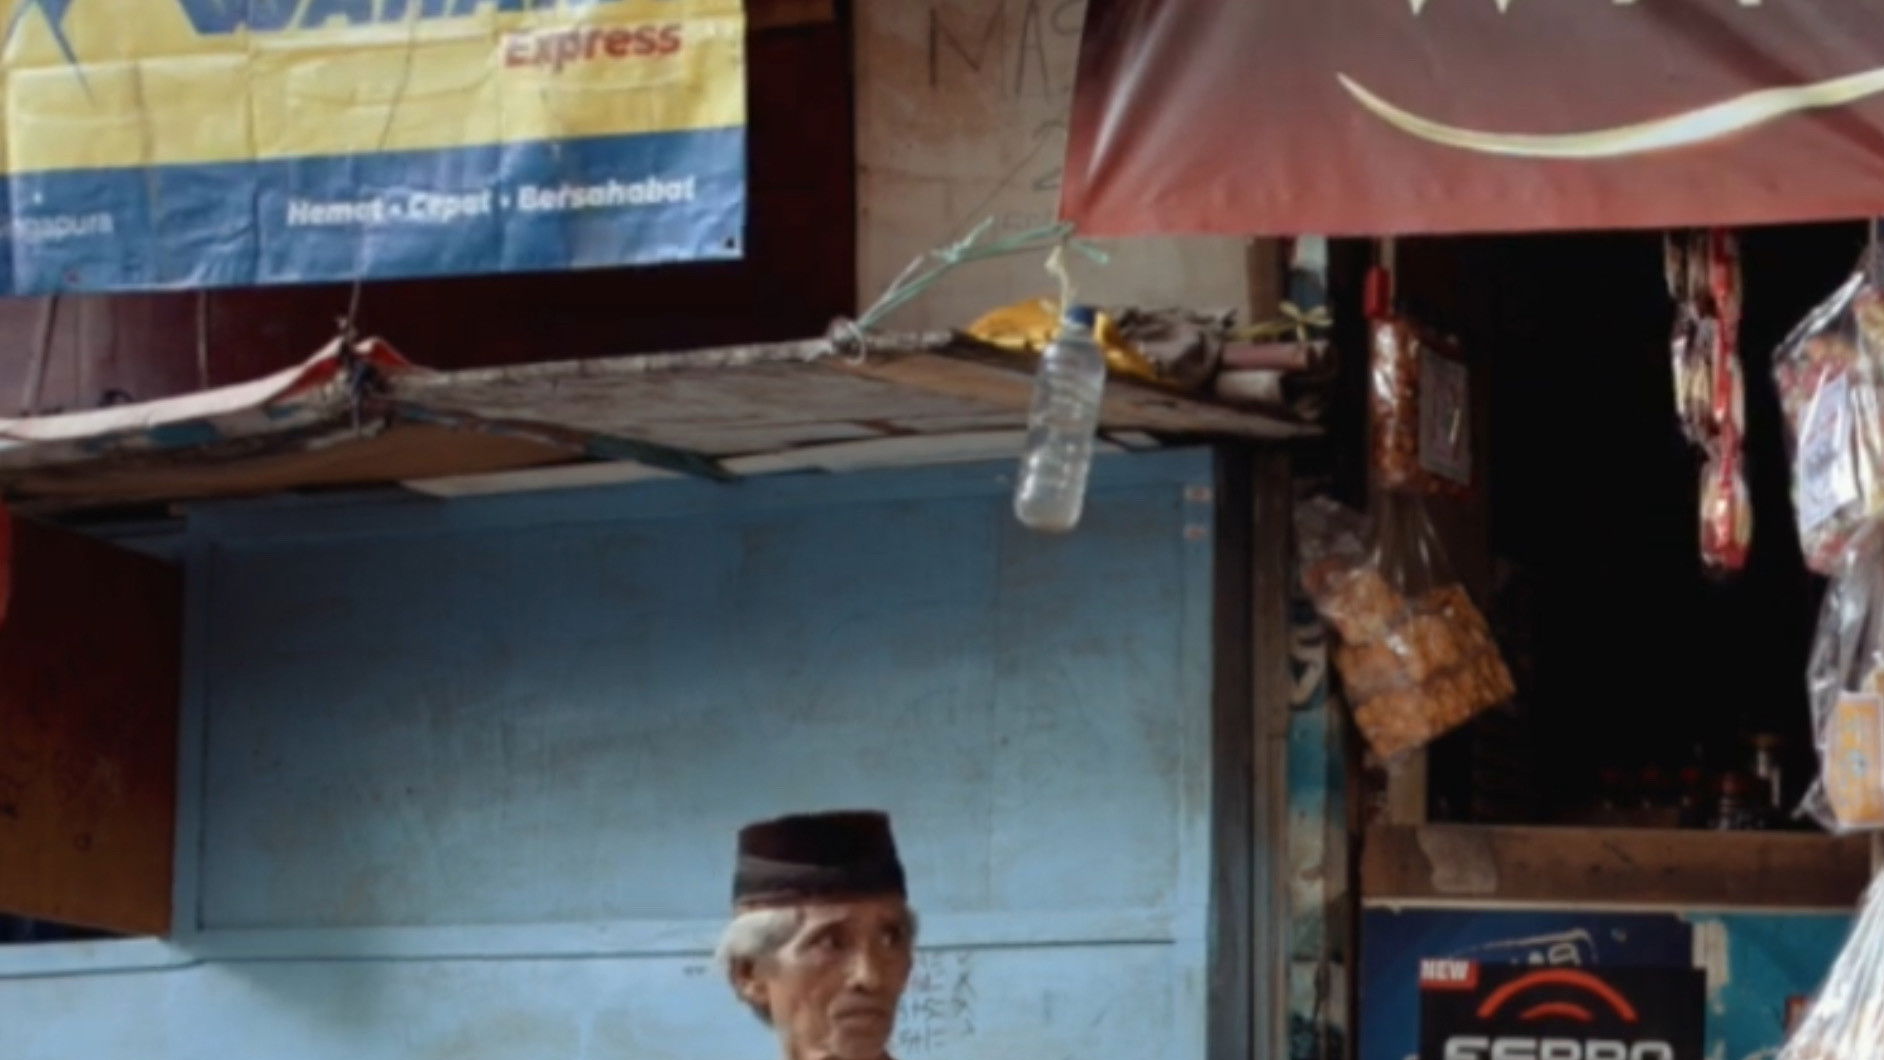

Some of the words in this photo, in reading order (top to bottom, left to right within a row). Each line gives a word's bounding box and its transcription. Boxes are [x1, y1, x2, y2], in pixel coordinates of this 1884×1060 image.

[505, 22, 682, 73] Express
[287, 199, 387, 227] Hemat
[408, 188, 492, 222] Cepat
[518, 173, 696, 212] Bersahabat
[1420, 959, 1471, 982] NEW
